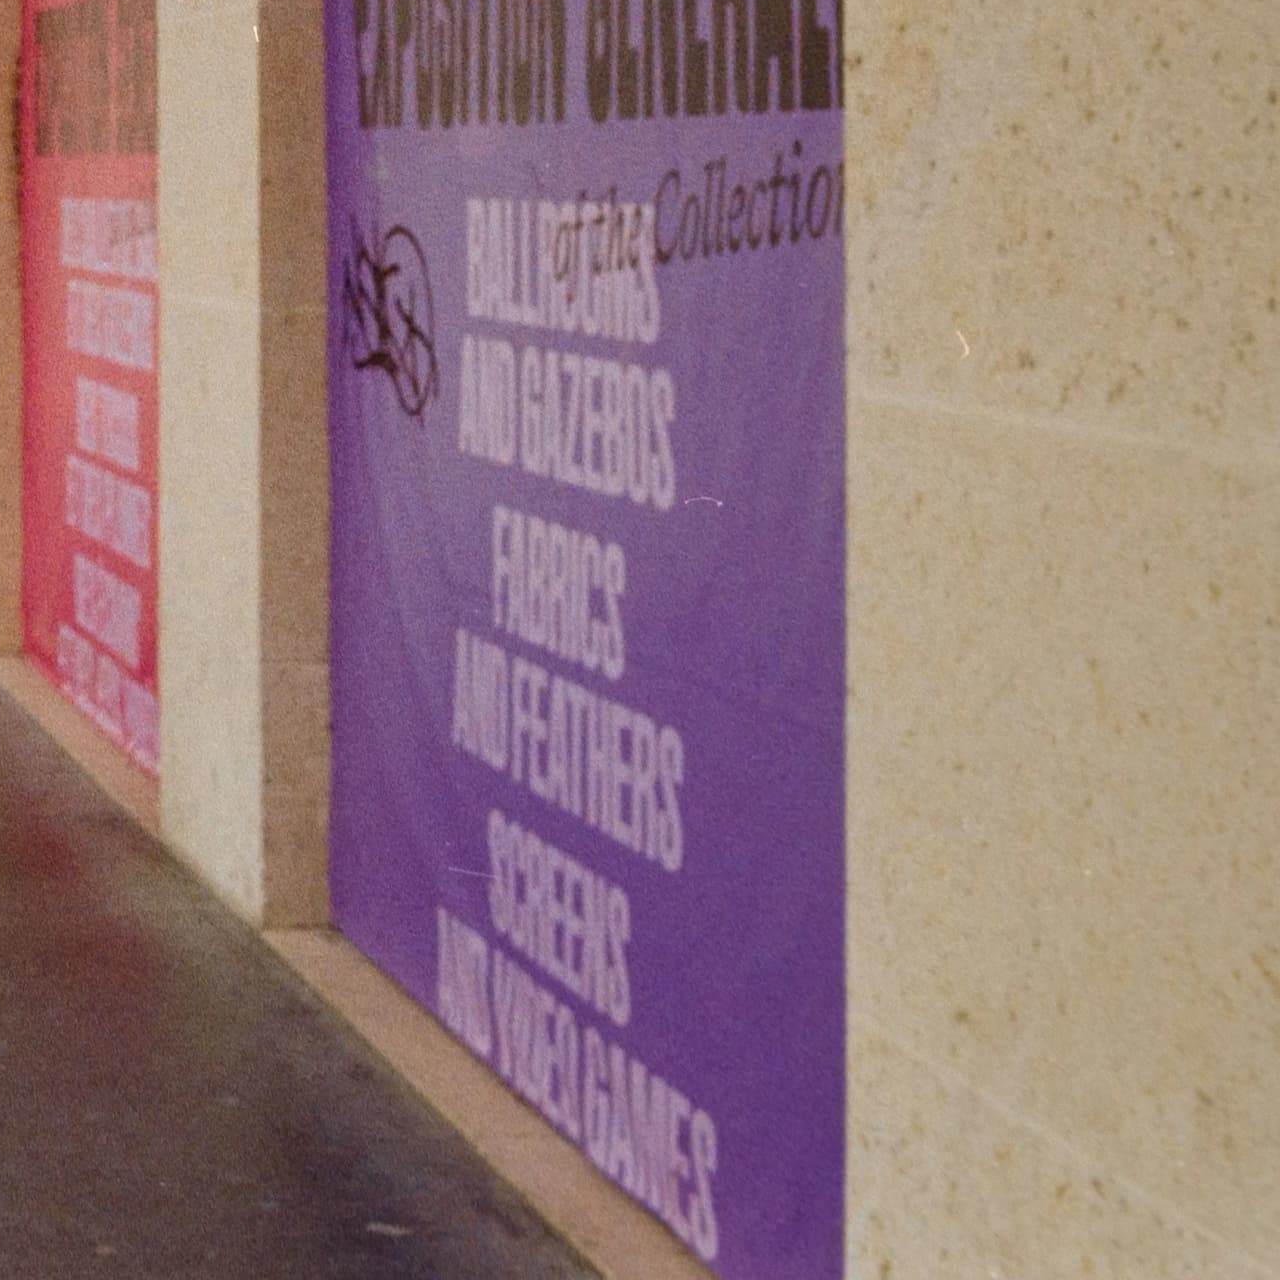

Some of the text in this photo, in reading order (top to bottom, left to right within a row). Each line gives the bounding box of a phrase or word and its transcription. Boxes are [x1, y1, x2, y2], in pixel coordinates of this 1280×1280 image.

[458, 334, 676, 510] AND GAZEBOS
[492, 505, 626, 680] FABRICS
[452, 627, 684, 872] AND FEATHERS
[488, 810, 631, 1027] SCREENS
[439, 906, 718, 1260] AND VIDEO GAMES
